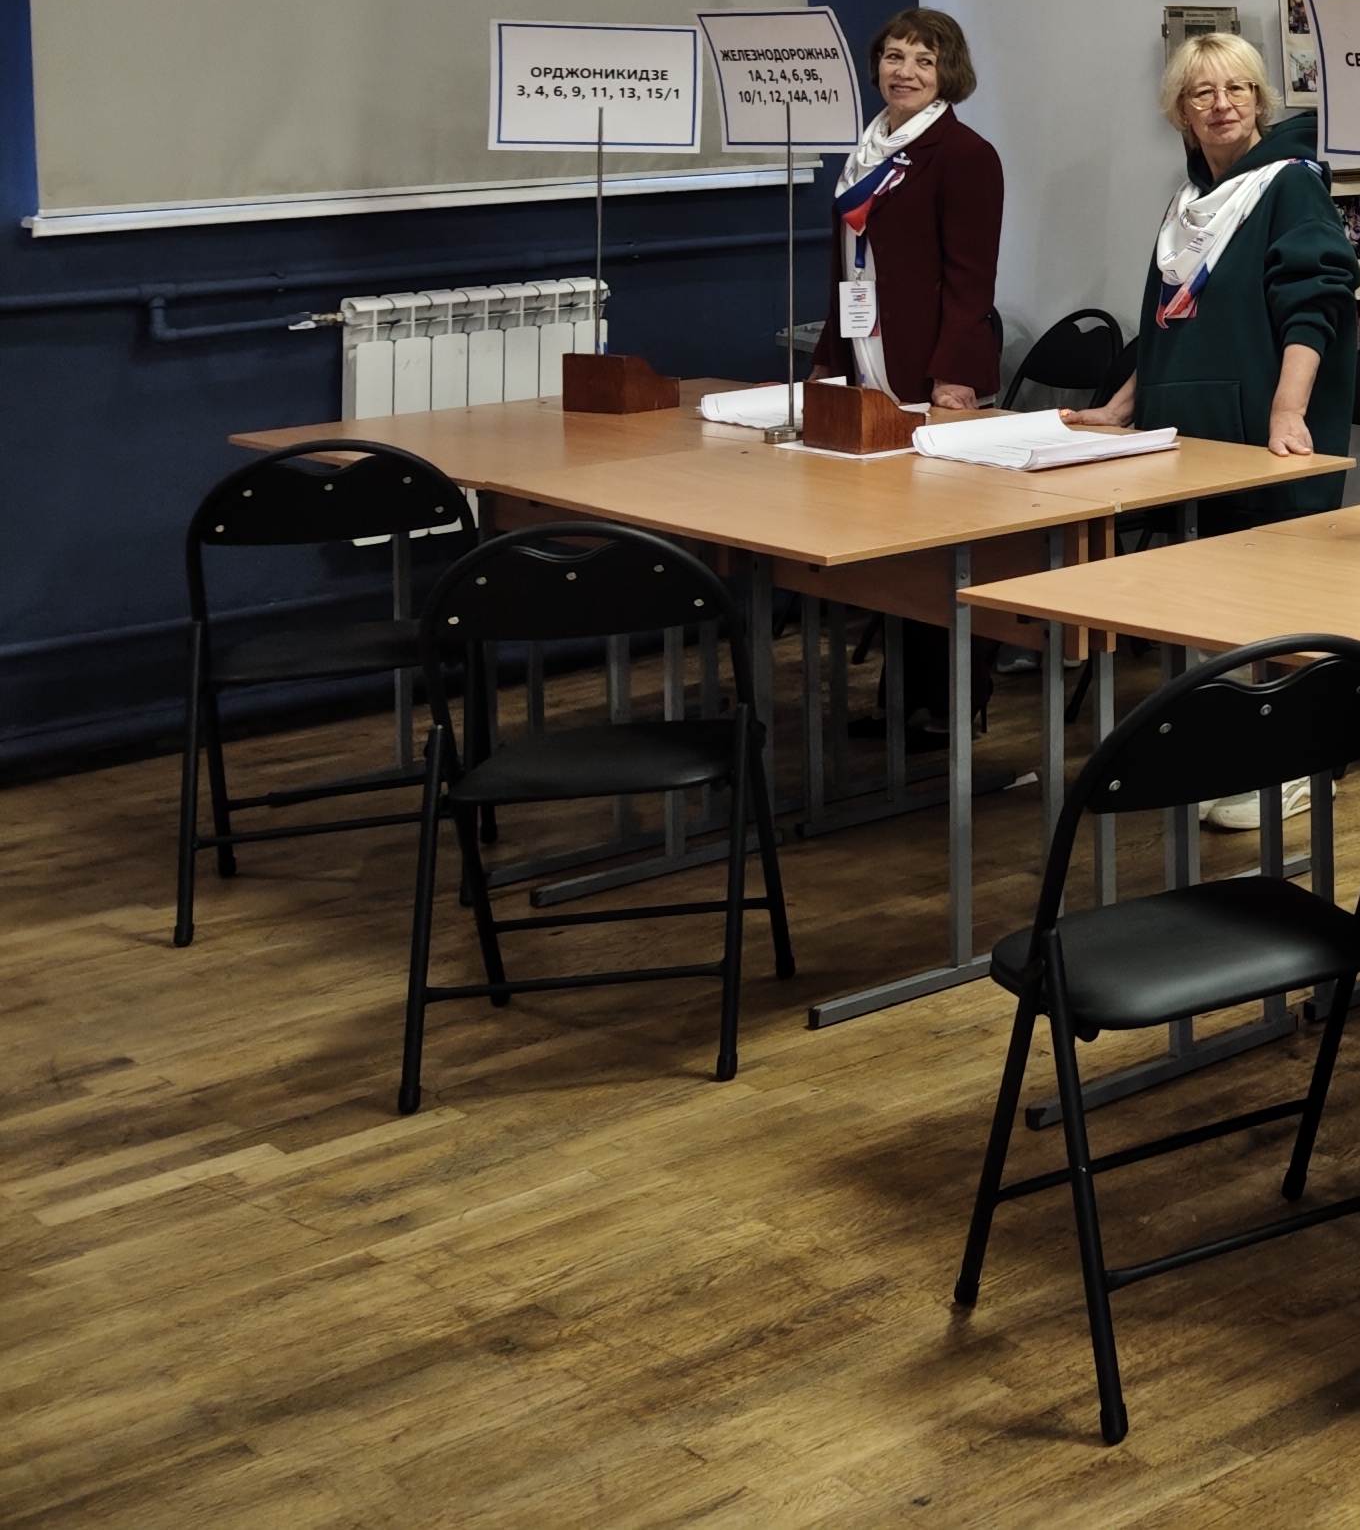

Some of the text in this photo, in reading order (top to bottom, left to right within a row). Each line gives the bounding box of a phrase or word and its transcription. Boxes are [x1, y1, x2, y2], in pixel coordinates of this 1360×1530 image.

[720, 48, 840, 63] ЖЕЛЕЗНОДОРОЖНАЯ
[530, 67, 669, 82] ОРДЖОНИКИДЗЕ
[748, 69, 823, 84] 1А, 2, 4, 6, 9Б,
[516, 85, 680, 101] 3, 4, 6, 9, 11, 13, 15/1
[738, 88, 839, 105] 10/1, 12, 14А, 14/1
